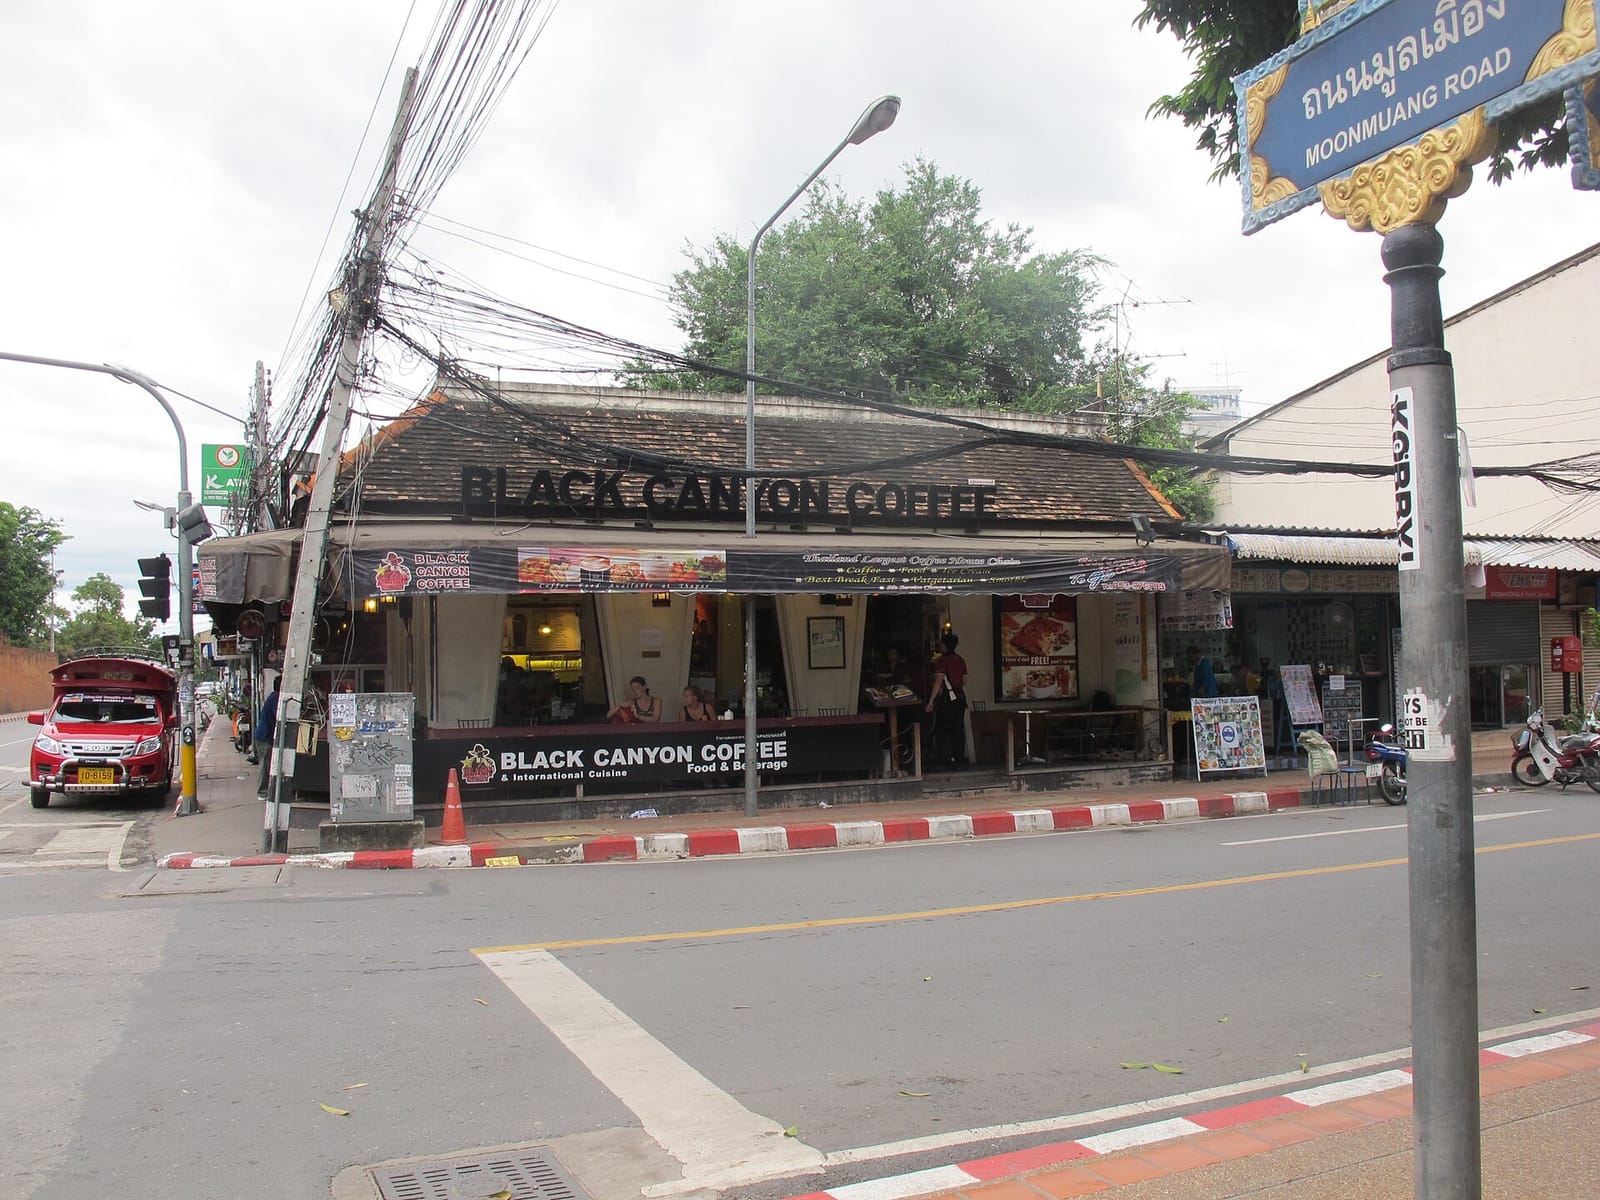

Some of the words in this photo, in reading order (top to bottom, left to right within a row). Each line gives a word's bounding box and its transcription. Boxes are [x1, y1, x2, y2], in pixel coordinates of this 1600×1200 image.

[1305, 85, 1437, 168] MOONMUANG
[1444, 47, 1511, 99] ROAD
[462, 466, 627, 507] BLACK
[642, 472, 829, 514] CANYON
[845, 481, 997, 519] COFFEE
[414, 553, 469, 565] BLACK
[802, 553, 859, 564] Thailand
[861, 555, 907, 566] Largest
[909, 555, 947, 567] Coffee
[987, 557, 1021, 566] Chain
[415, 566, 470, 577] CANYON
[846, 566, 881, 576] Coffee
[899, 566, 928, 574] Food
[416, 578, 470, 589] COFFEE
[1031, 656, 1050, 665] FREE!
[1415, 717, 1428, 726] BE
[501, 750, 584, 770] BLACK
[594, 745, 693, 766] CANYON
[701, 740, 788, 761] COFEE
[687, 762, 715, 774] Food
[719, 761, 730, 772] &
[733, 759, 788, 773] Beerage
[80, 771, 113, 780] 10-6159
[501, 774, 508, 782] &
[513, 770, 584, 781] International
[588, 768, 628, 779] Cuisine
